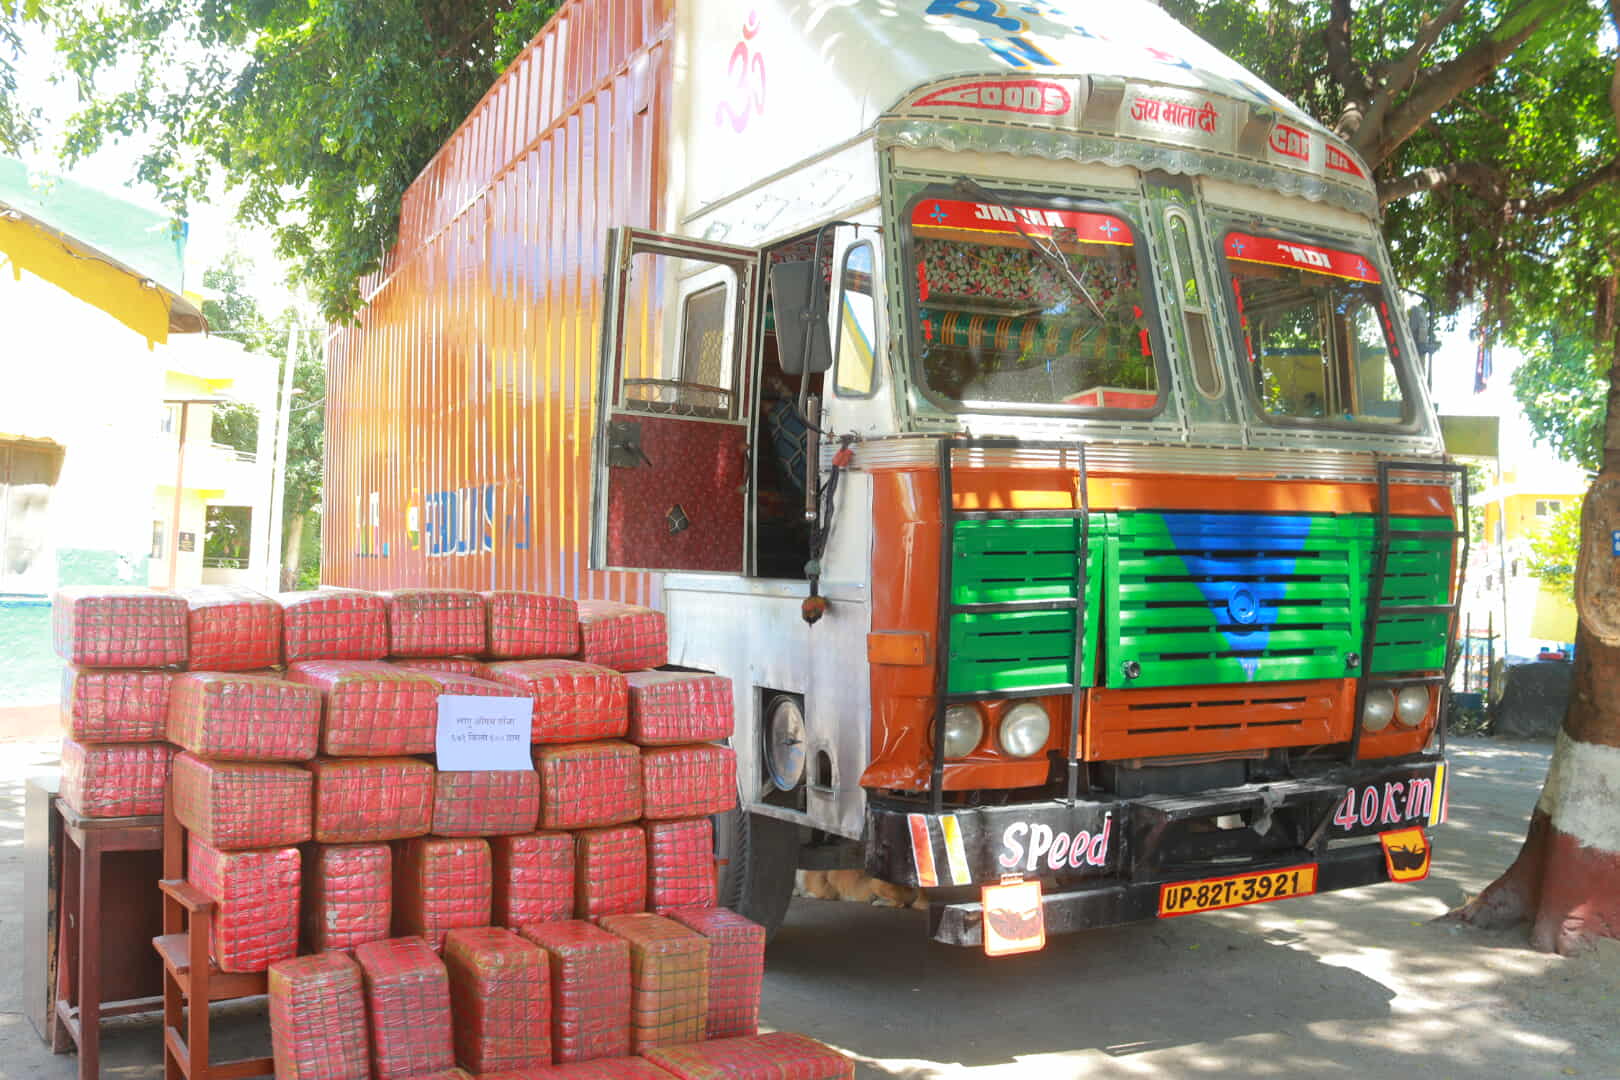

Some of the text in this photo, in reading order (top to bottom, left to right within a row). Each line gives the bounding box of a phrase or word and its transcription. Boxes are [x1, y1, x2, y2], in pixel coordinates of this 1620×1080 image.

[920, 83, 1066, 114] GOODS
[1130, 98, 1222, 136] जय माता दी
